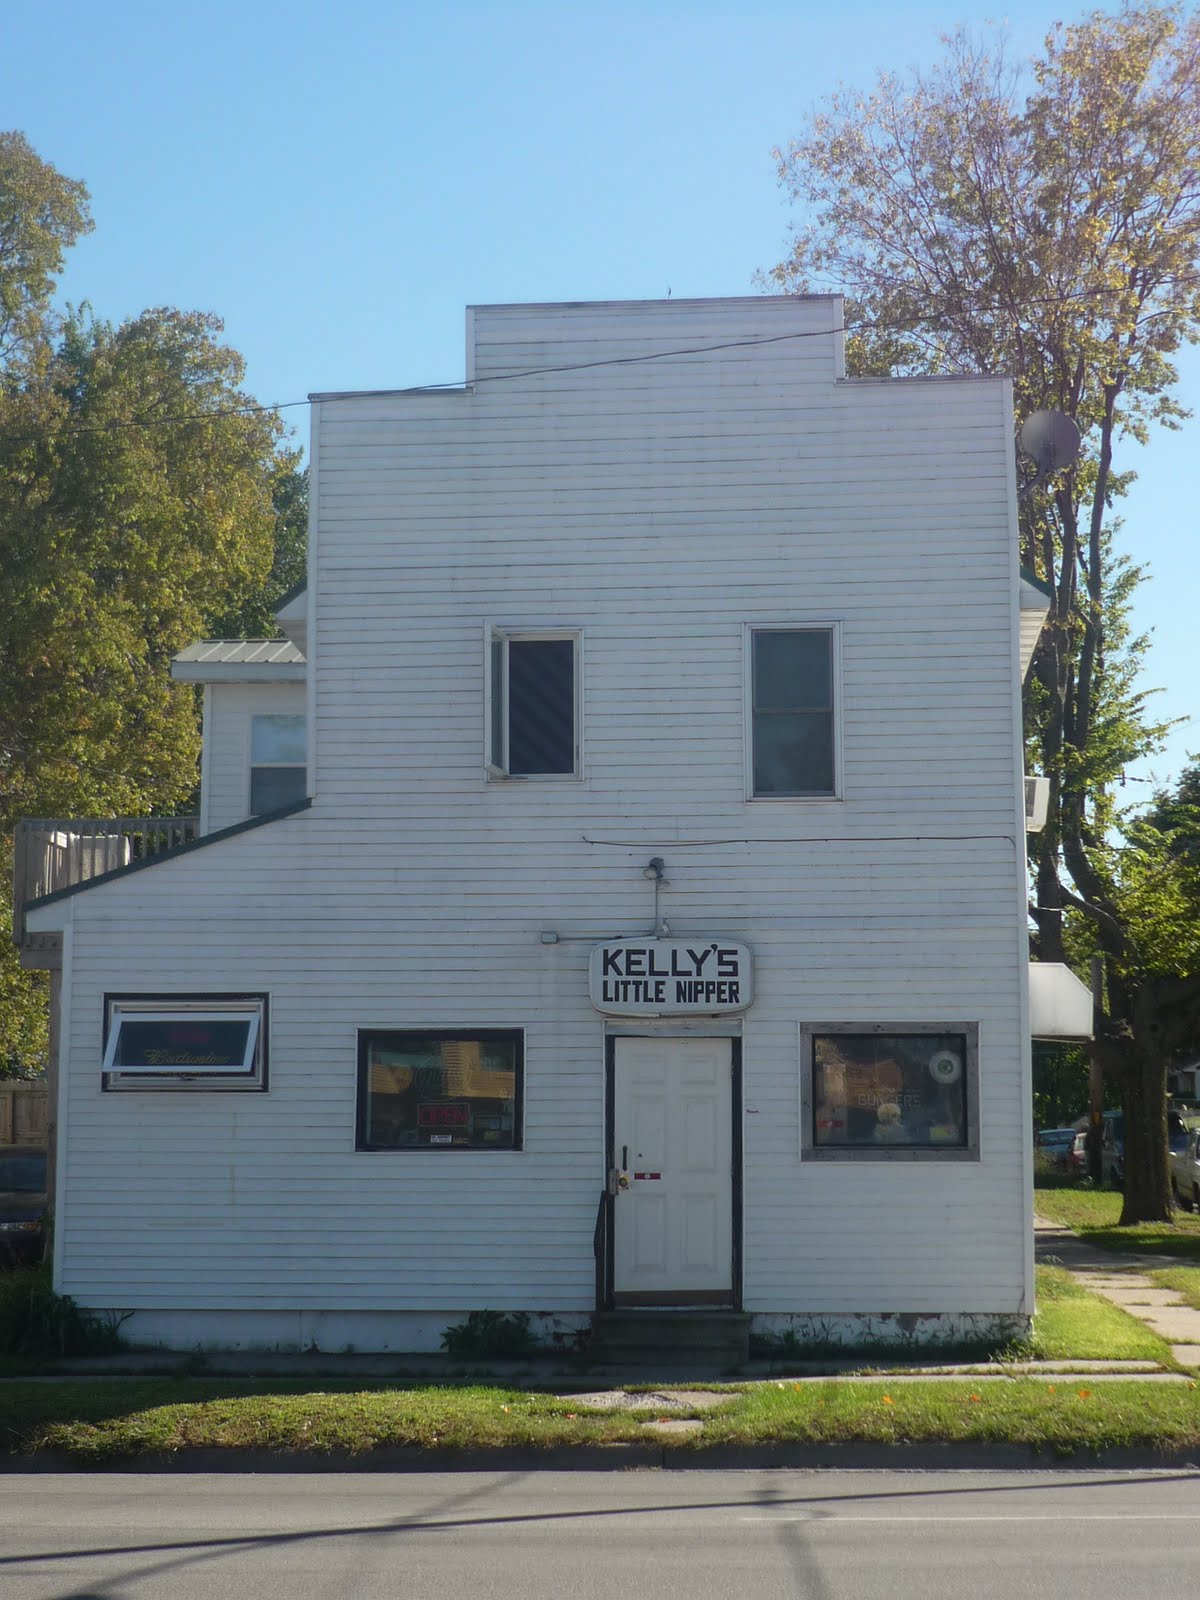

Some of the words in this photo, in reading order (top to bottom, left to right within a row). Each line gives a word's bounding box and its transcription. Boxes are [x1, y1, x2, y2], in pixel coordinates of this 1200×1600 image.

[602, 944, 739, 977] KELLY'S
[602, 980, 666, 1003] LITTLE
[676, 980, 740, 1003] NIPPER
